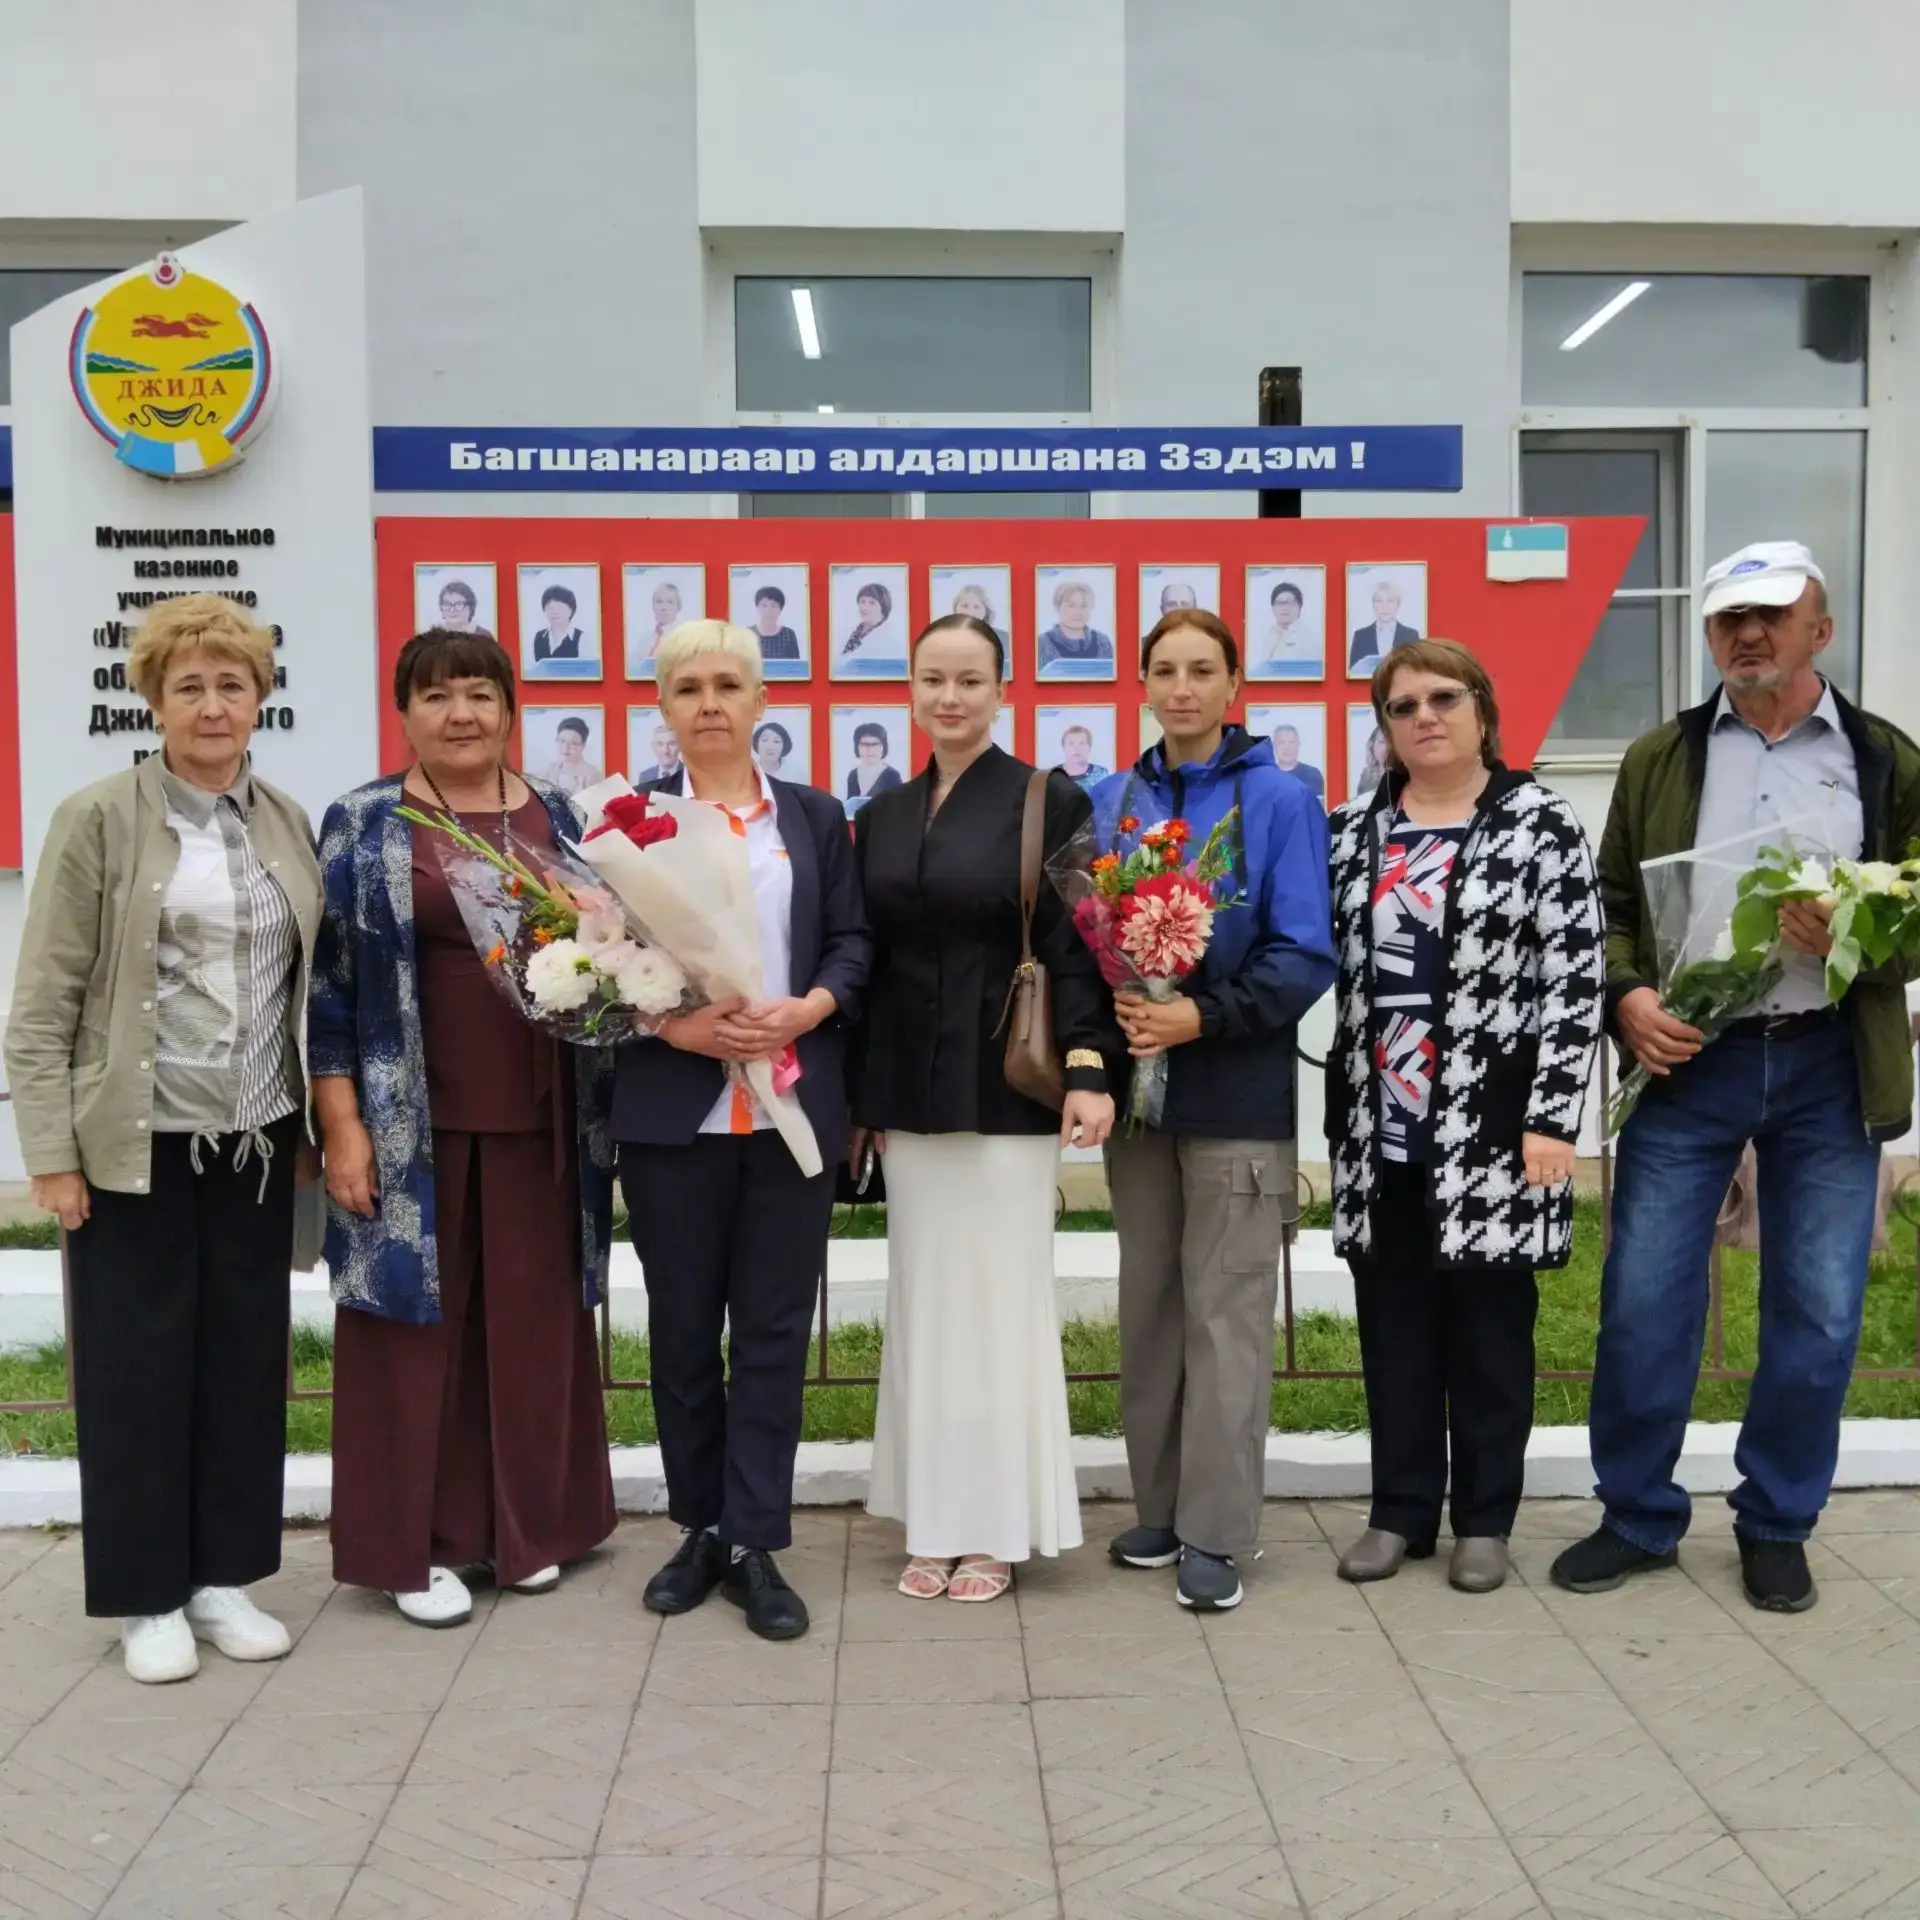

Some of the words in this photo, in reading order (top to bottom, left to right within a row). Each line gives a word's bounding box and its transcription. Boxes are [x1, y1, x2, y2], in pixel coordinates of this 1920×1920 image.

[117, 377, 228, 401] ДЖИДА
[450, 442, 816, 474] Багшанараар
[829, 448, 1146, 475] алдаршана
[1160, 443, 1336, 474] Зэдэм
[95, 526, 276, 548] Муниципальное
[134, 559, 239, 578] казенное
